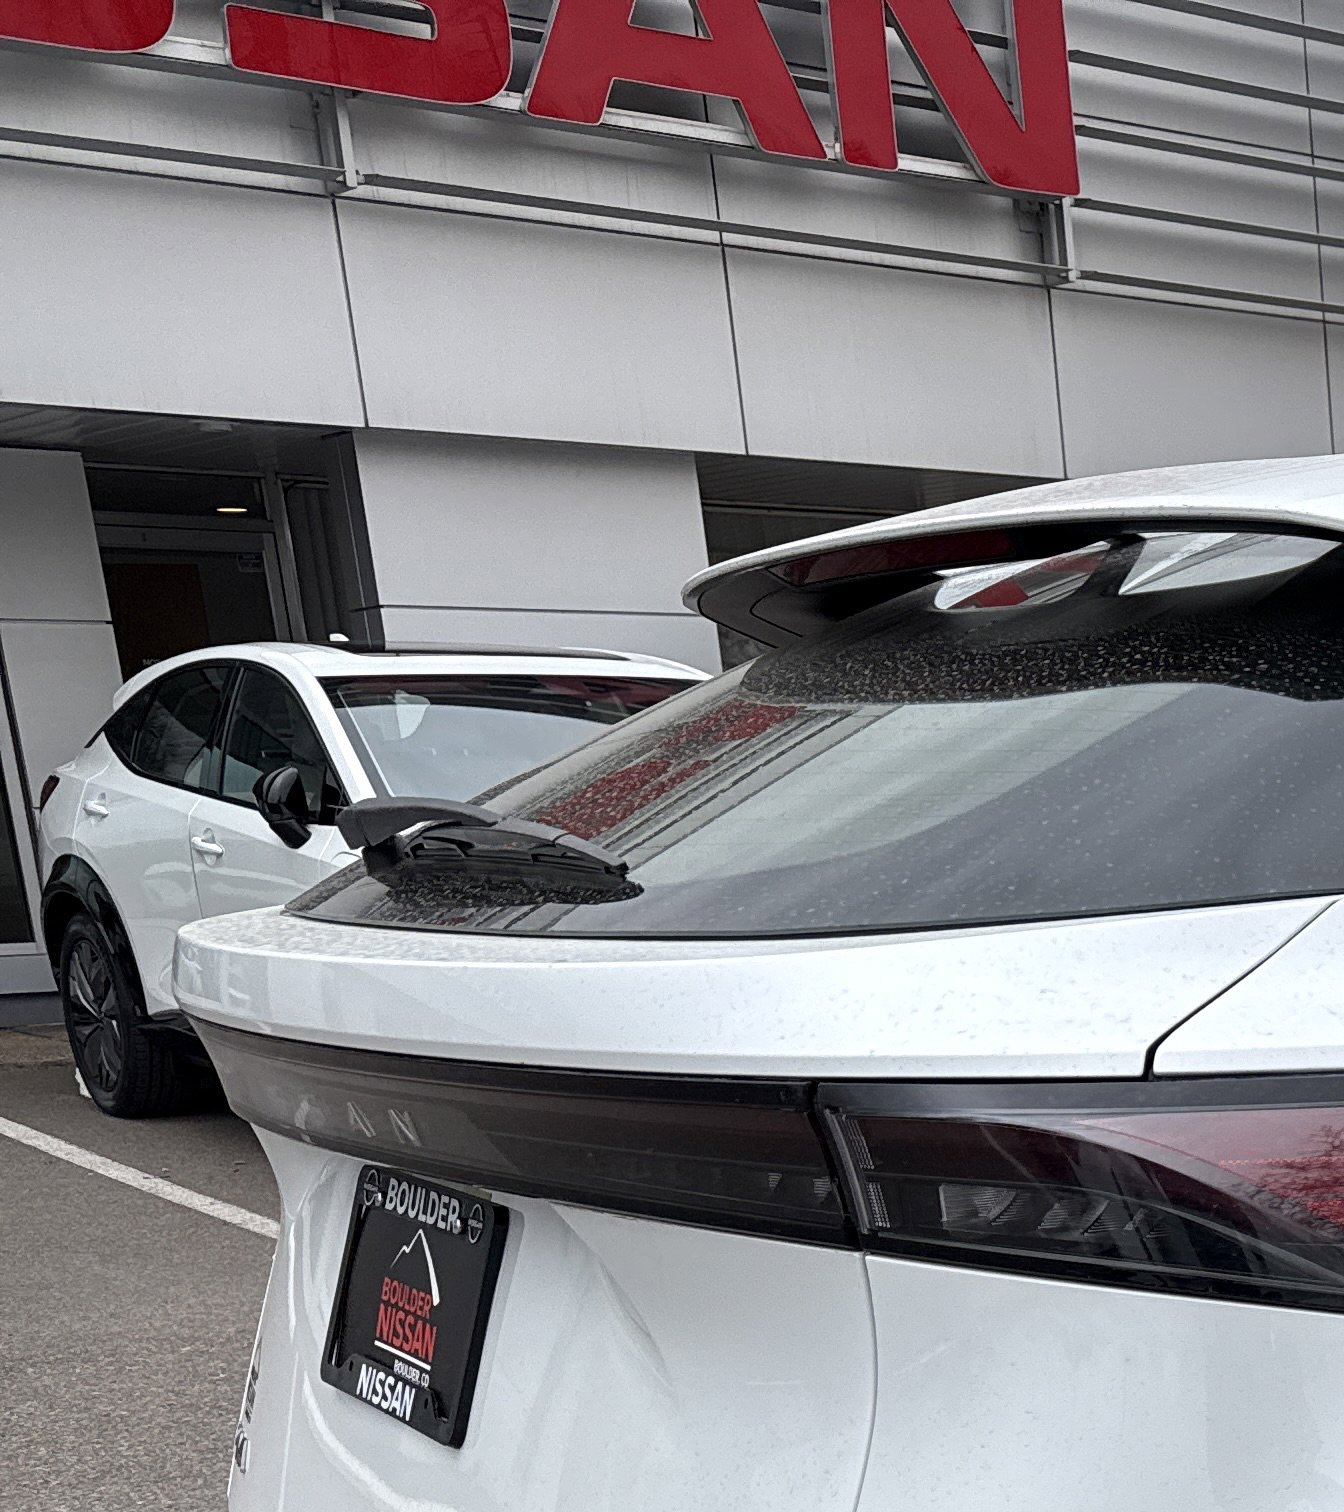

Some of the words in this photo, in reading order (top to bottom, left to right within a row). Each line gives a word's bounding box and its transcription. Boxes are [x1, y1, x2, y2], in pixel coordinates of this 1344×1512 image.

[384, 1177, 460, 1232] BOULDER
[381, 1276, 432, 1319] BOULDER
[376, 1302, 437, 1362] NISSAN
[356, 1363, 416, 1421] NISSAN
